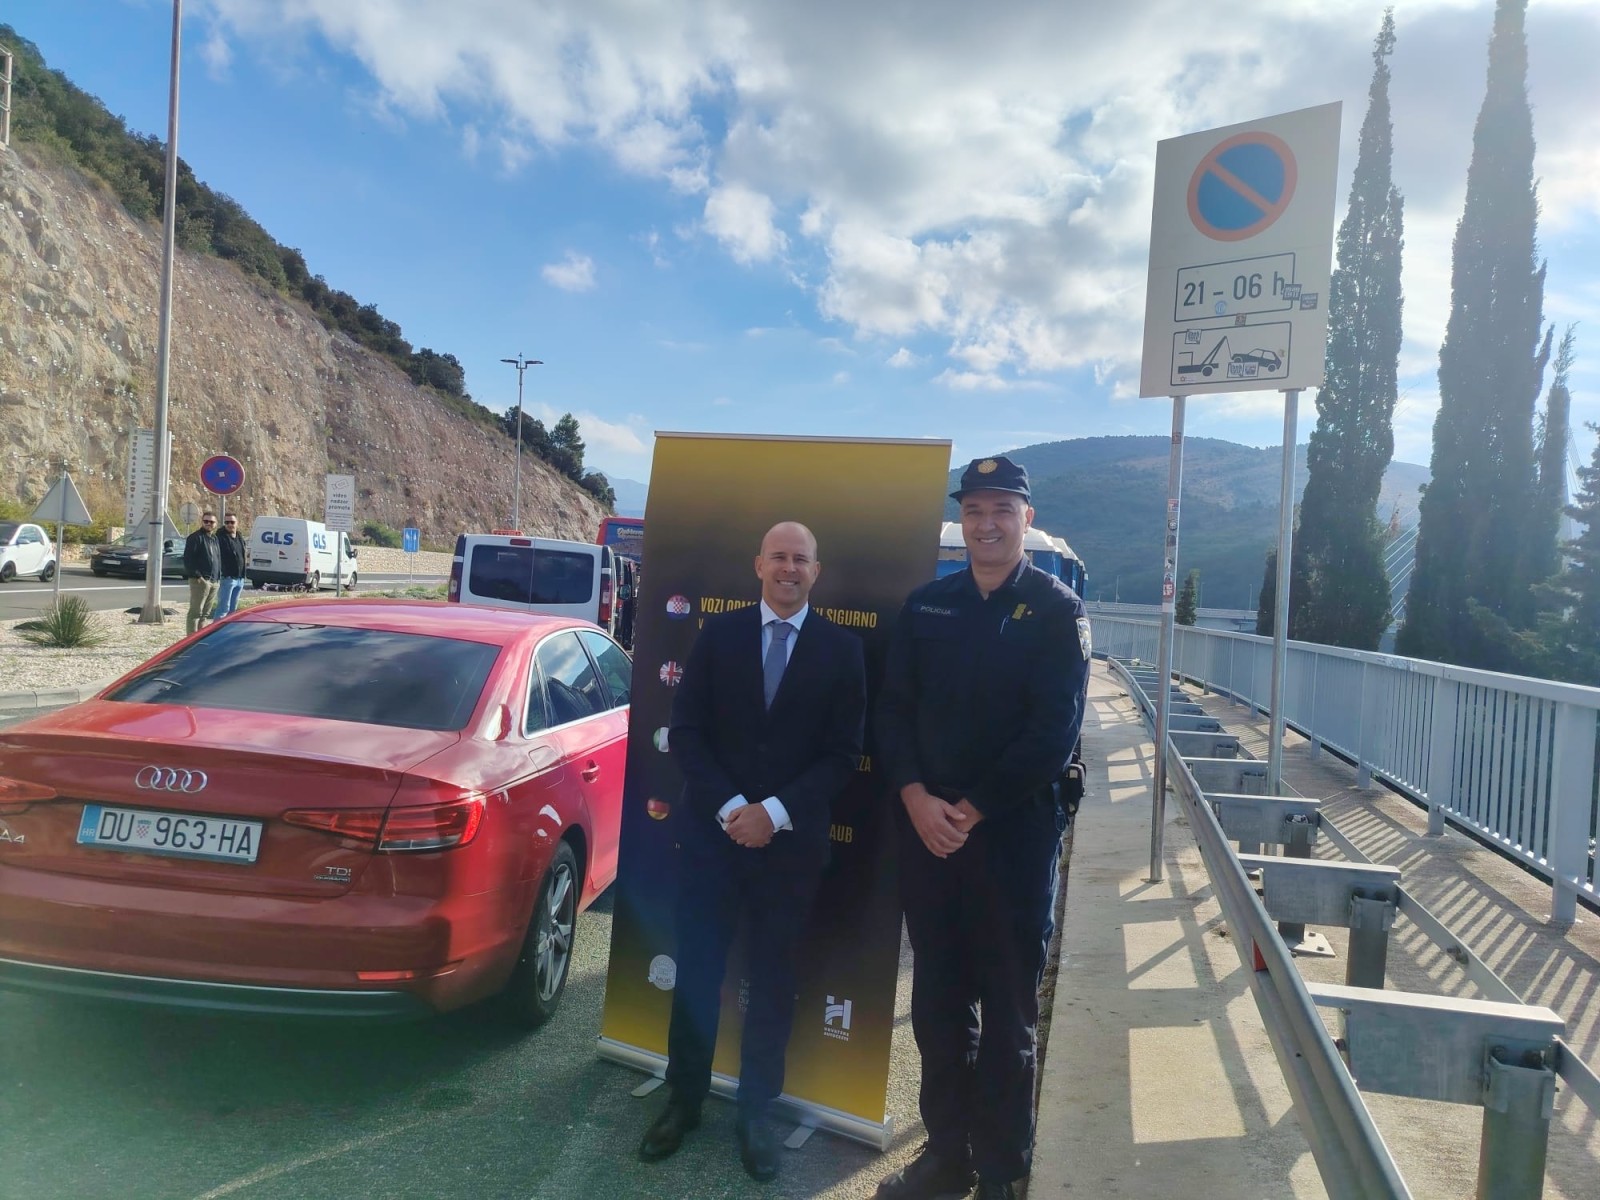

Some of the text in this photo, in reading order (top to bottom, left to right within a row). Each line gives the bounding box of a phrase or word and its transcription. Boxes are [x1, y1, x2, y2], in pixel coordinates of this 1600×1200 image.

[1183, 281, 1204, 307] 21
[1233, 273, 1262, 301] 06
[1272, 271, 1285, 296] h
[261, 531, 294, 546] GLS
[312, 533, 327, 550] GLS
[700, 597, 724, 614] VOZI
[826, 608, 878, 629] SIGURNO
[82, 827, 95, 838] HR
[98, 811, 252, 856] DU 963-HA
